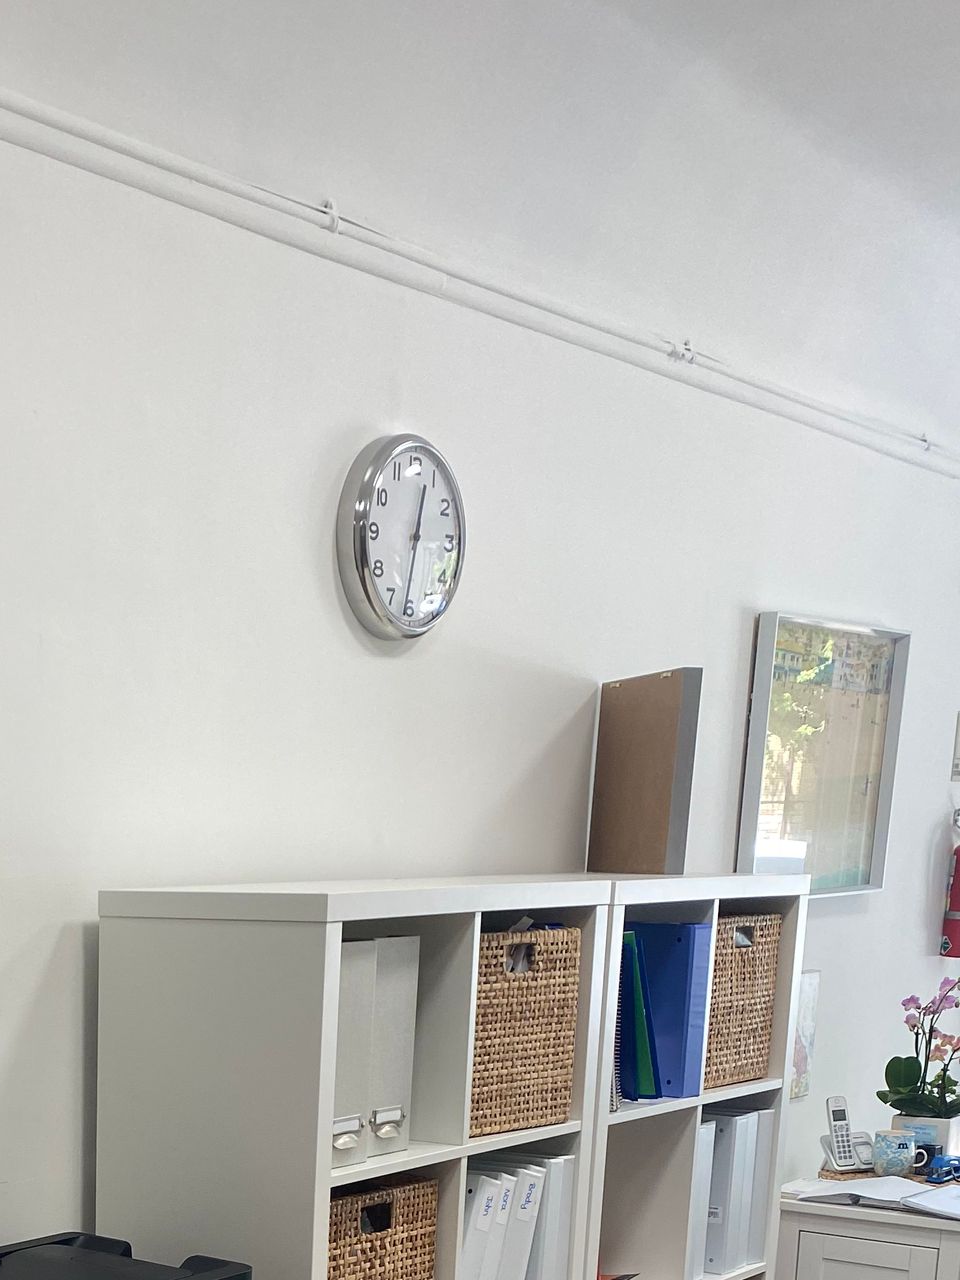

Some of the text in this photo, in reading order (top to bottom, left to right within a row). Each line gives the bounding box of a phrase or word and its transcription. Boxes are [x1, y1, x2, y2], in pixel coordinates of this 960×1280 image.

[393, 461, 401, 481] 11
[409, 455, 422, 475] 12
[376, 488, 388, 507] 10
[440, 499, 450, 516] 2
[369, 522, 380, 540] 9
[443, 535, 455, 552] 3
[373, 559, 384, 577] 8
[437, 569, 447, 584] 4
[386, 588, 396, 606] 7
[405, 600, 415, 617] 6
[897, 1142, 909, 1150] m
[500, 1189, 510, 1211] Nora
[520, 1182, 536, 1210] Brady
